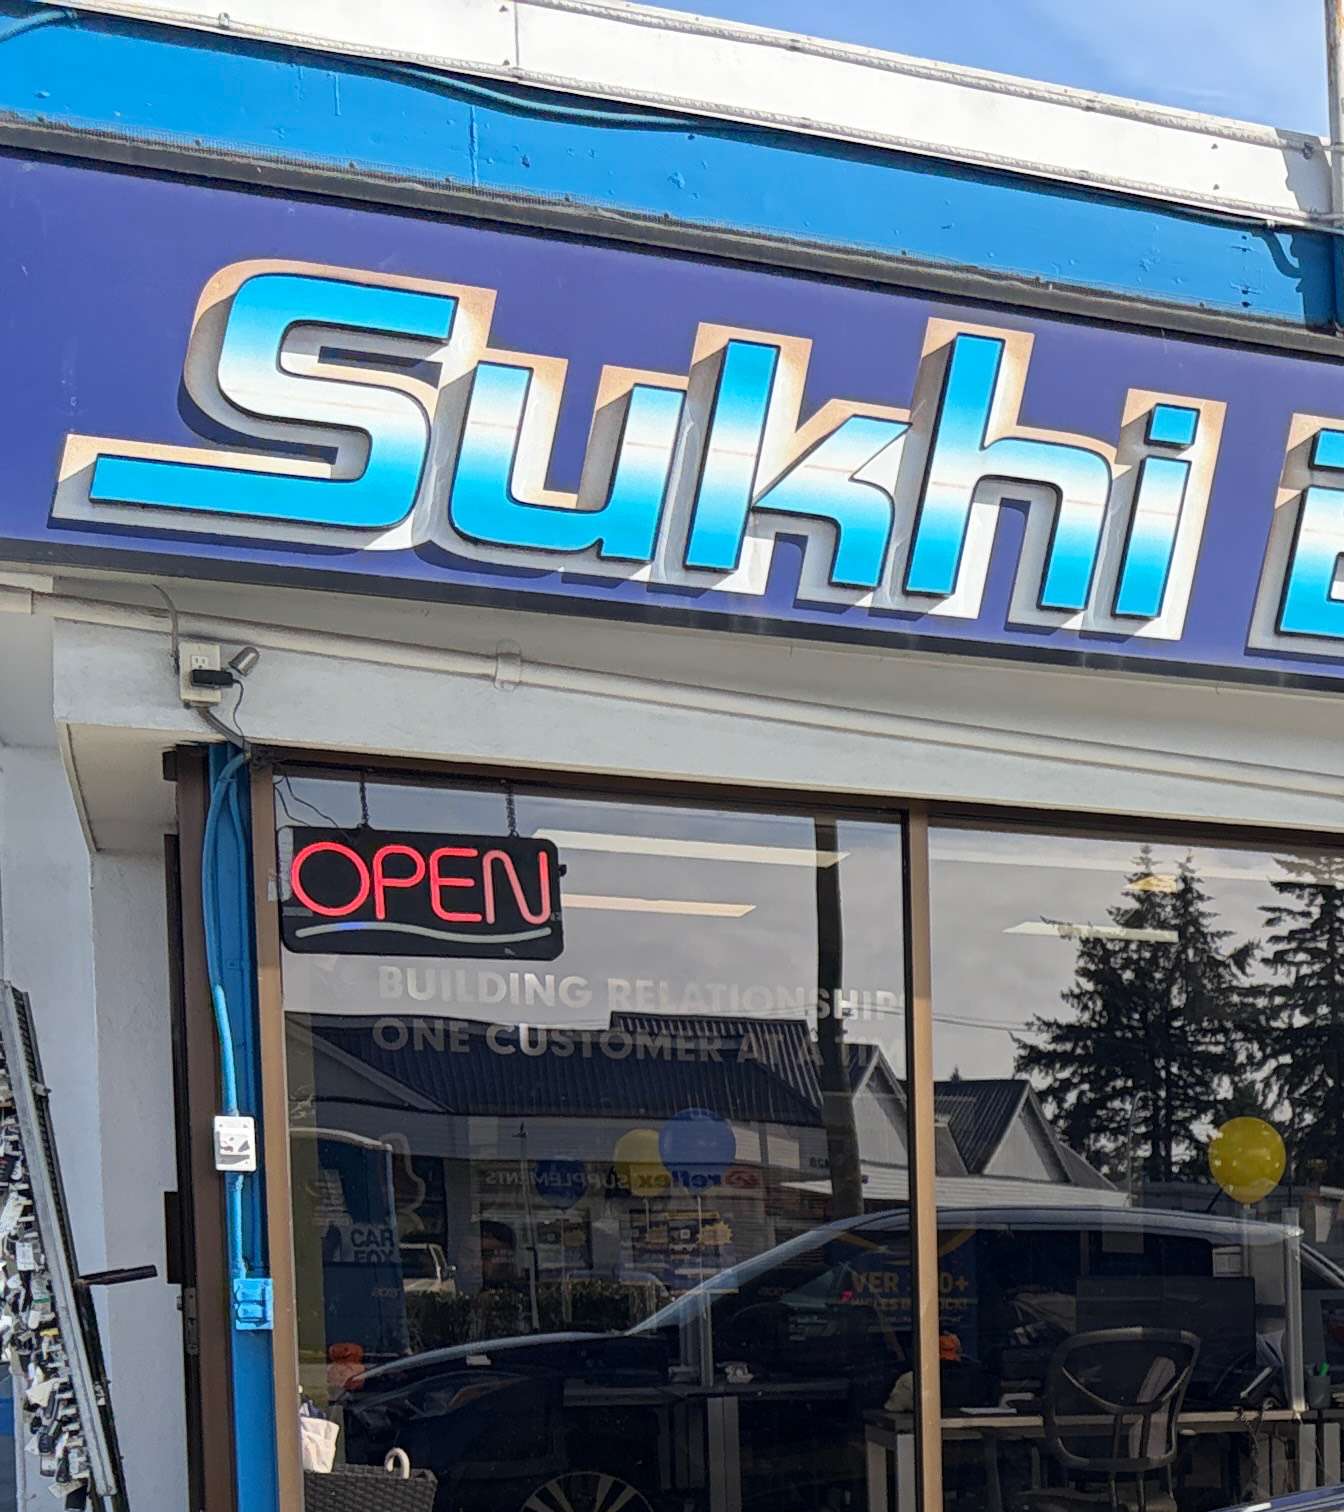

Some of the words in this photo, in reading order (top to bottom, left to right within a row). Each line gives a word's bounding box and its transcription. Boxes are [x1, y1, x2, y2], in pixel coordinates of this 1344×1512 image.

[48, 258, 1228, 641] Sukhi
[290, 841, 551, 926] OPEN
[378, 965, 593, 1009] BUILDING
[606, 976, 905, 1021] RELATIONSHIP
[372, 1017, 470, 1053] ONE
[485, 1022, 723, 1064] CUSTOMER
[736, 1031, 786, 1066] AT
[350, 1227, 395, 1249] CAR
